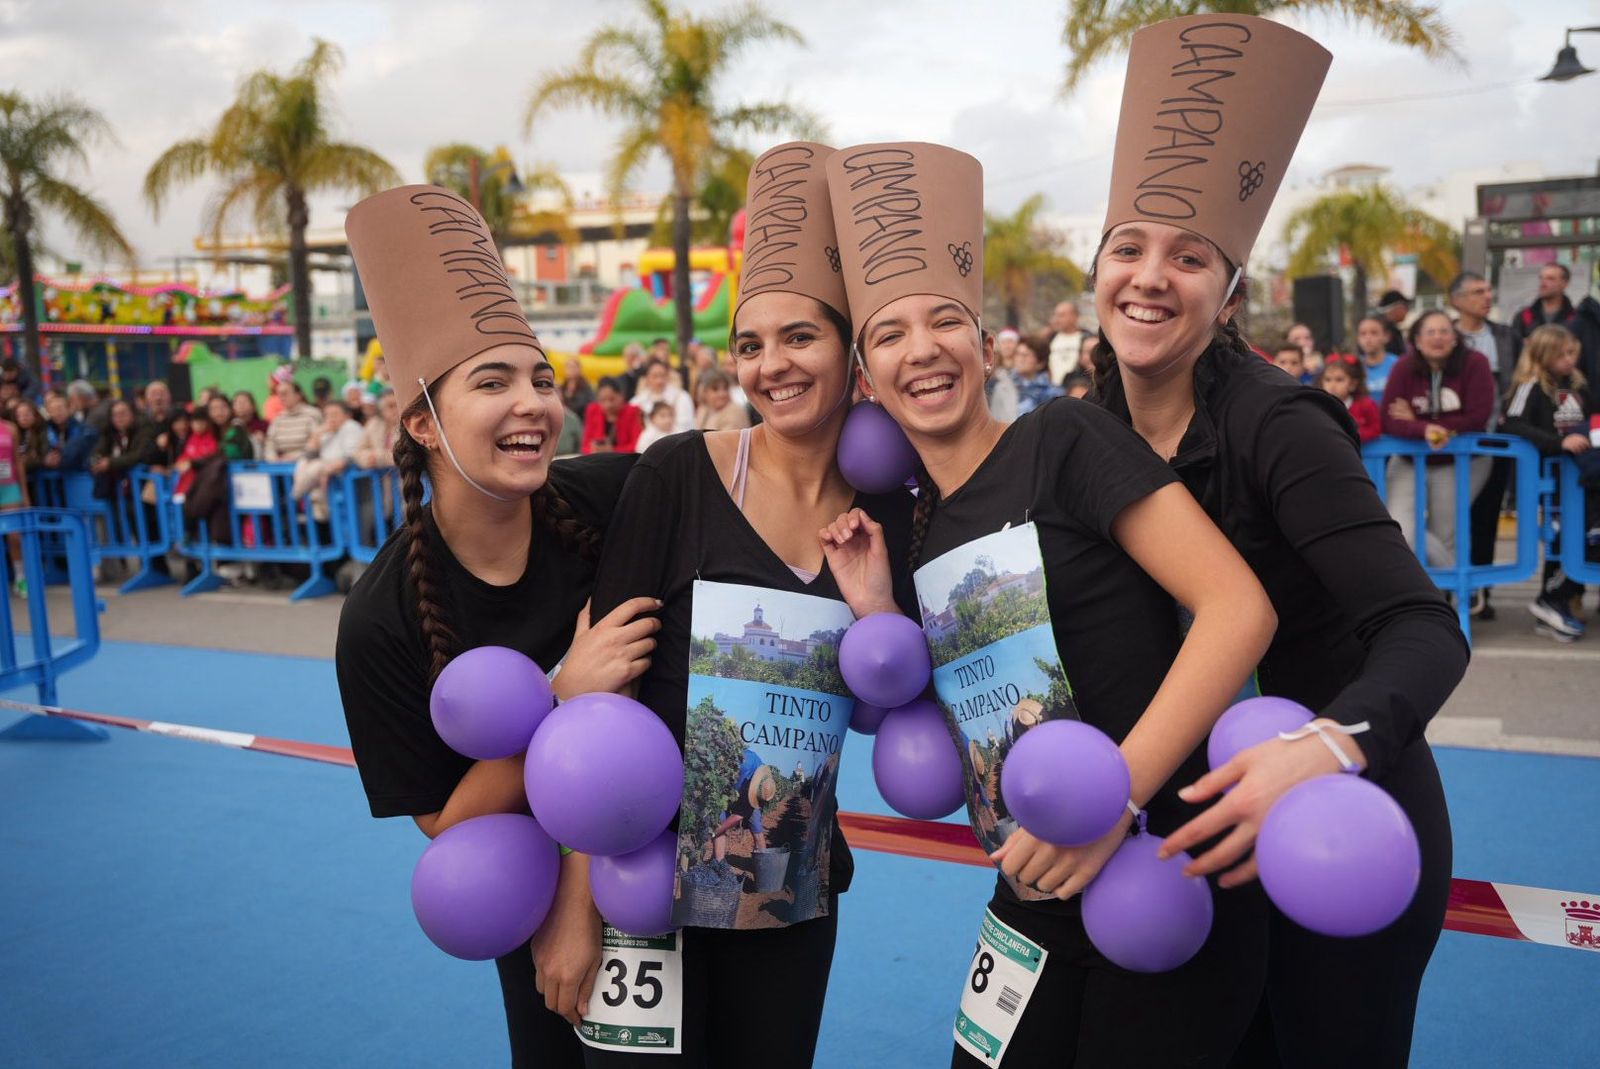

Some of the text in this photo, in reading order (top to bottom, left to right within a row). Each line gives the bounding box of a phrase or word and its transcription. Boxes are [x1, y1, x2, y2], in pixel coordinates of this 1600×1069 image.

[1134, 22, 1251, 219] CAMPANO
[742, 147, 814, 294] CAMPANO
[843, 149, 927, 285] CAMPANO
[410, 192, 537, 340] CAMPANO
[954, 655, 995, 689] TINTO
[766, 692, 831, 722] TINTO
[740, 721, 839, 754] CAMPANO
[992, 926, 1031, 958] CHICLANERA
[602, 958, 663, 1009] 35
